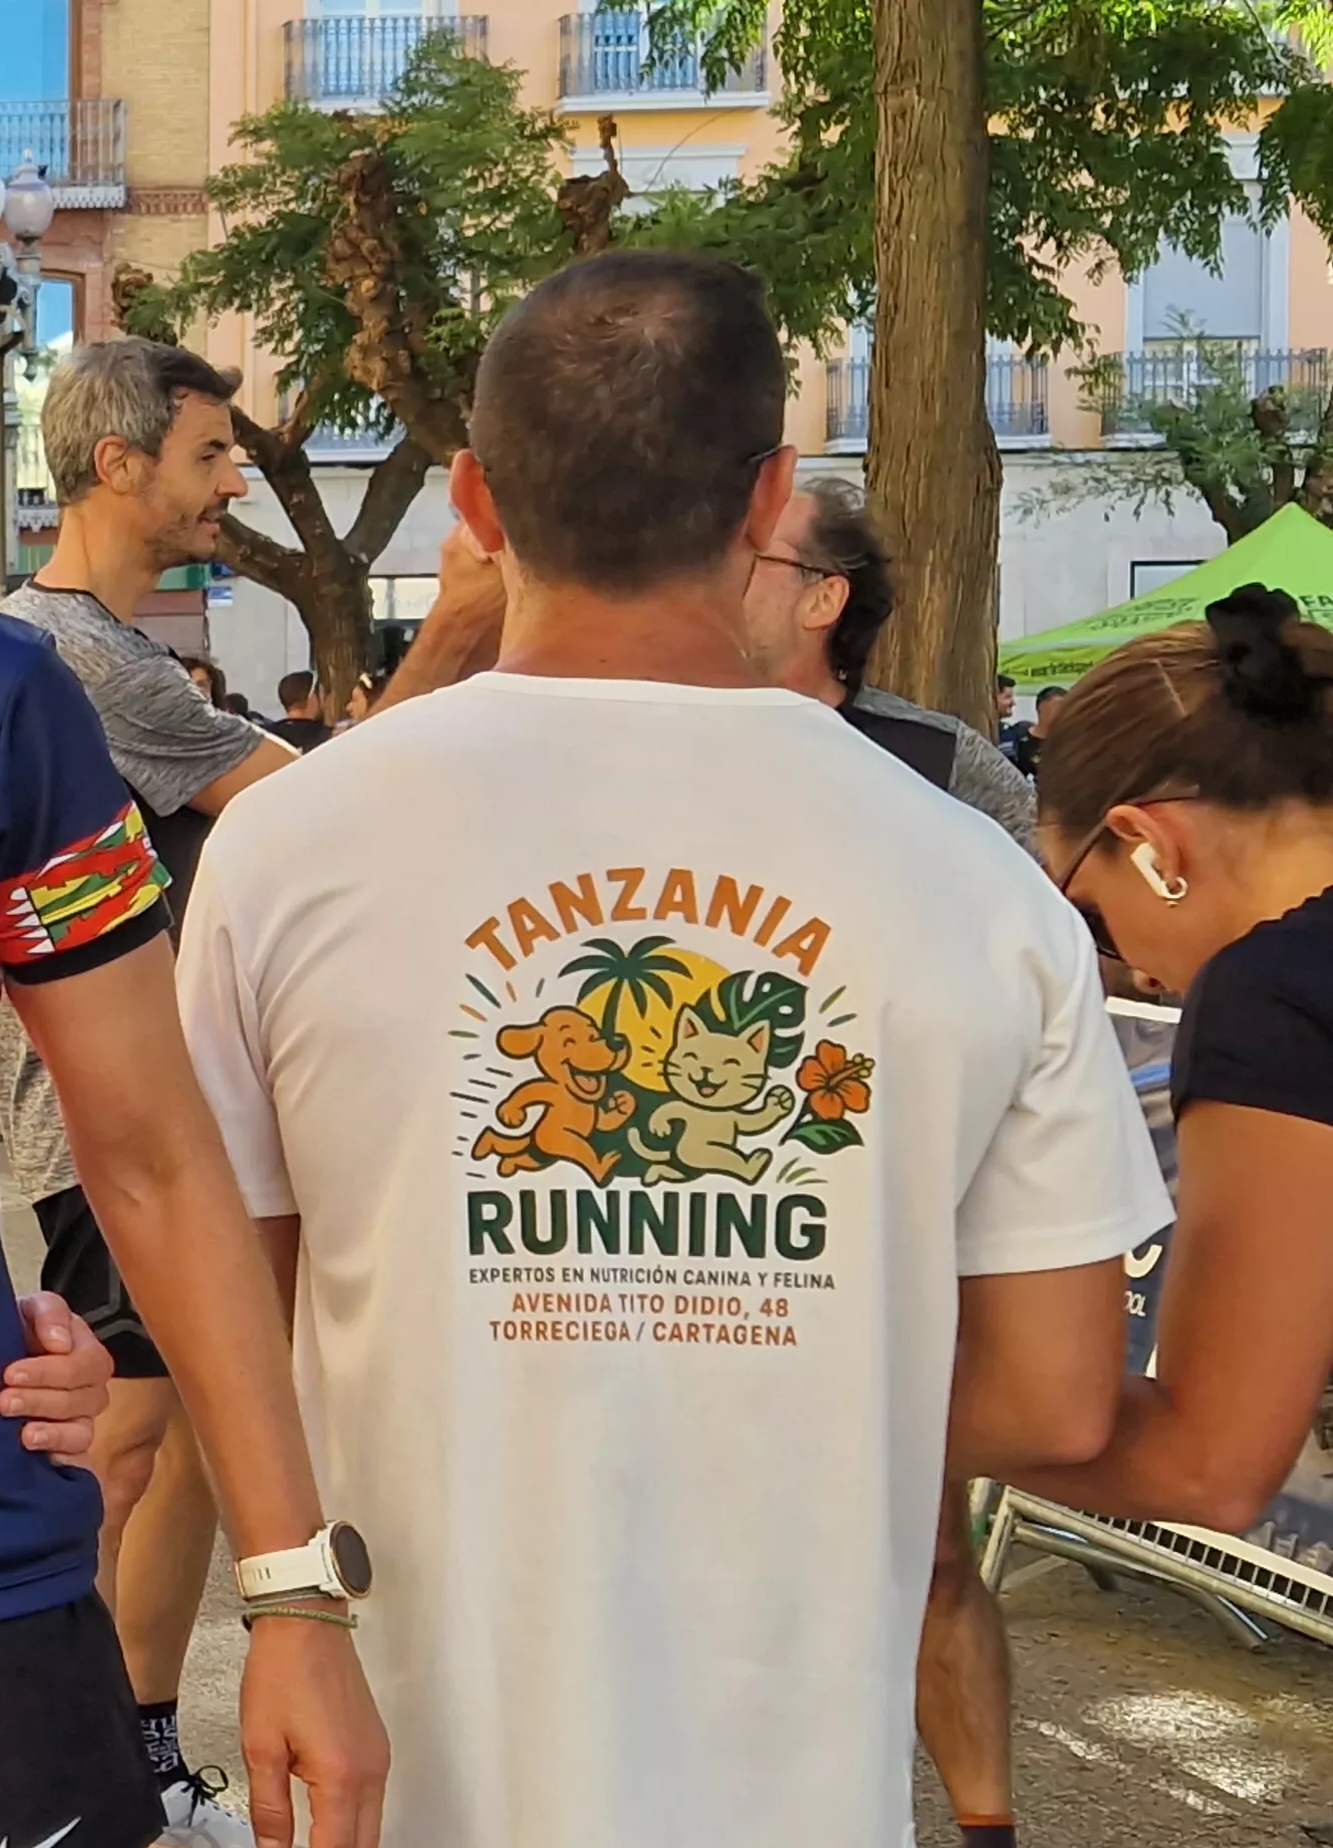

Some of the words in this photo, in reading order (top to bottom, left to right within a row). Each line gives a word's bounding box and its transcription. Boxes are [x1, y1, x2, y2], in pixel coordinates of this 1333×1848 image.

[465, 866, 833, 977] TANZANIA
[466, 1188, 828, 1261] RUNNING
[469, 1267, 555, 1285] EXPERTOS
[562, 1268, 584, 1284] EN
[590, 1264, 677, 1286] NUTRICIÓN
[682, 1269, 751, 1288] CANINA
[758, 1271, 768, 1287] Y
[773, 1271, 835, 1290] FELINA
[511, 1292, 612, 1314] AVENIDA
[618, 1293, 665, 1314] TITO
[674, 1295, 750, 1320] DIDIO,
[759, 1297, 789, 1317] 48
[489, 1319, 631, 1343] TORRECIEGA
[652, 1322, 797, 1346] CARTAGENA
